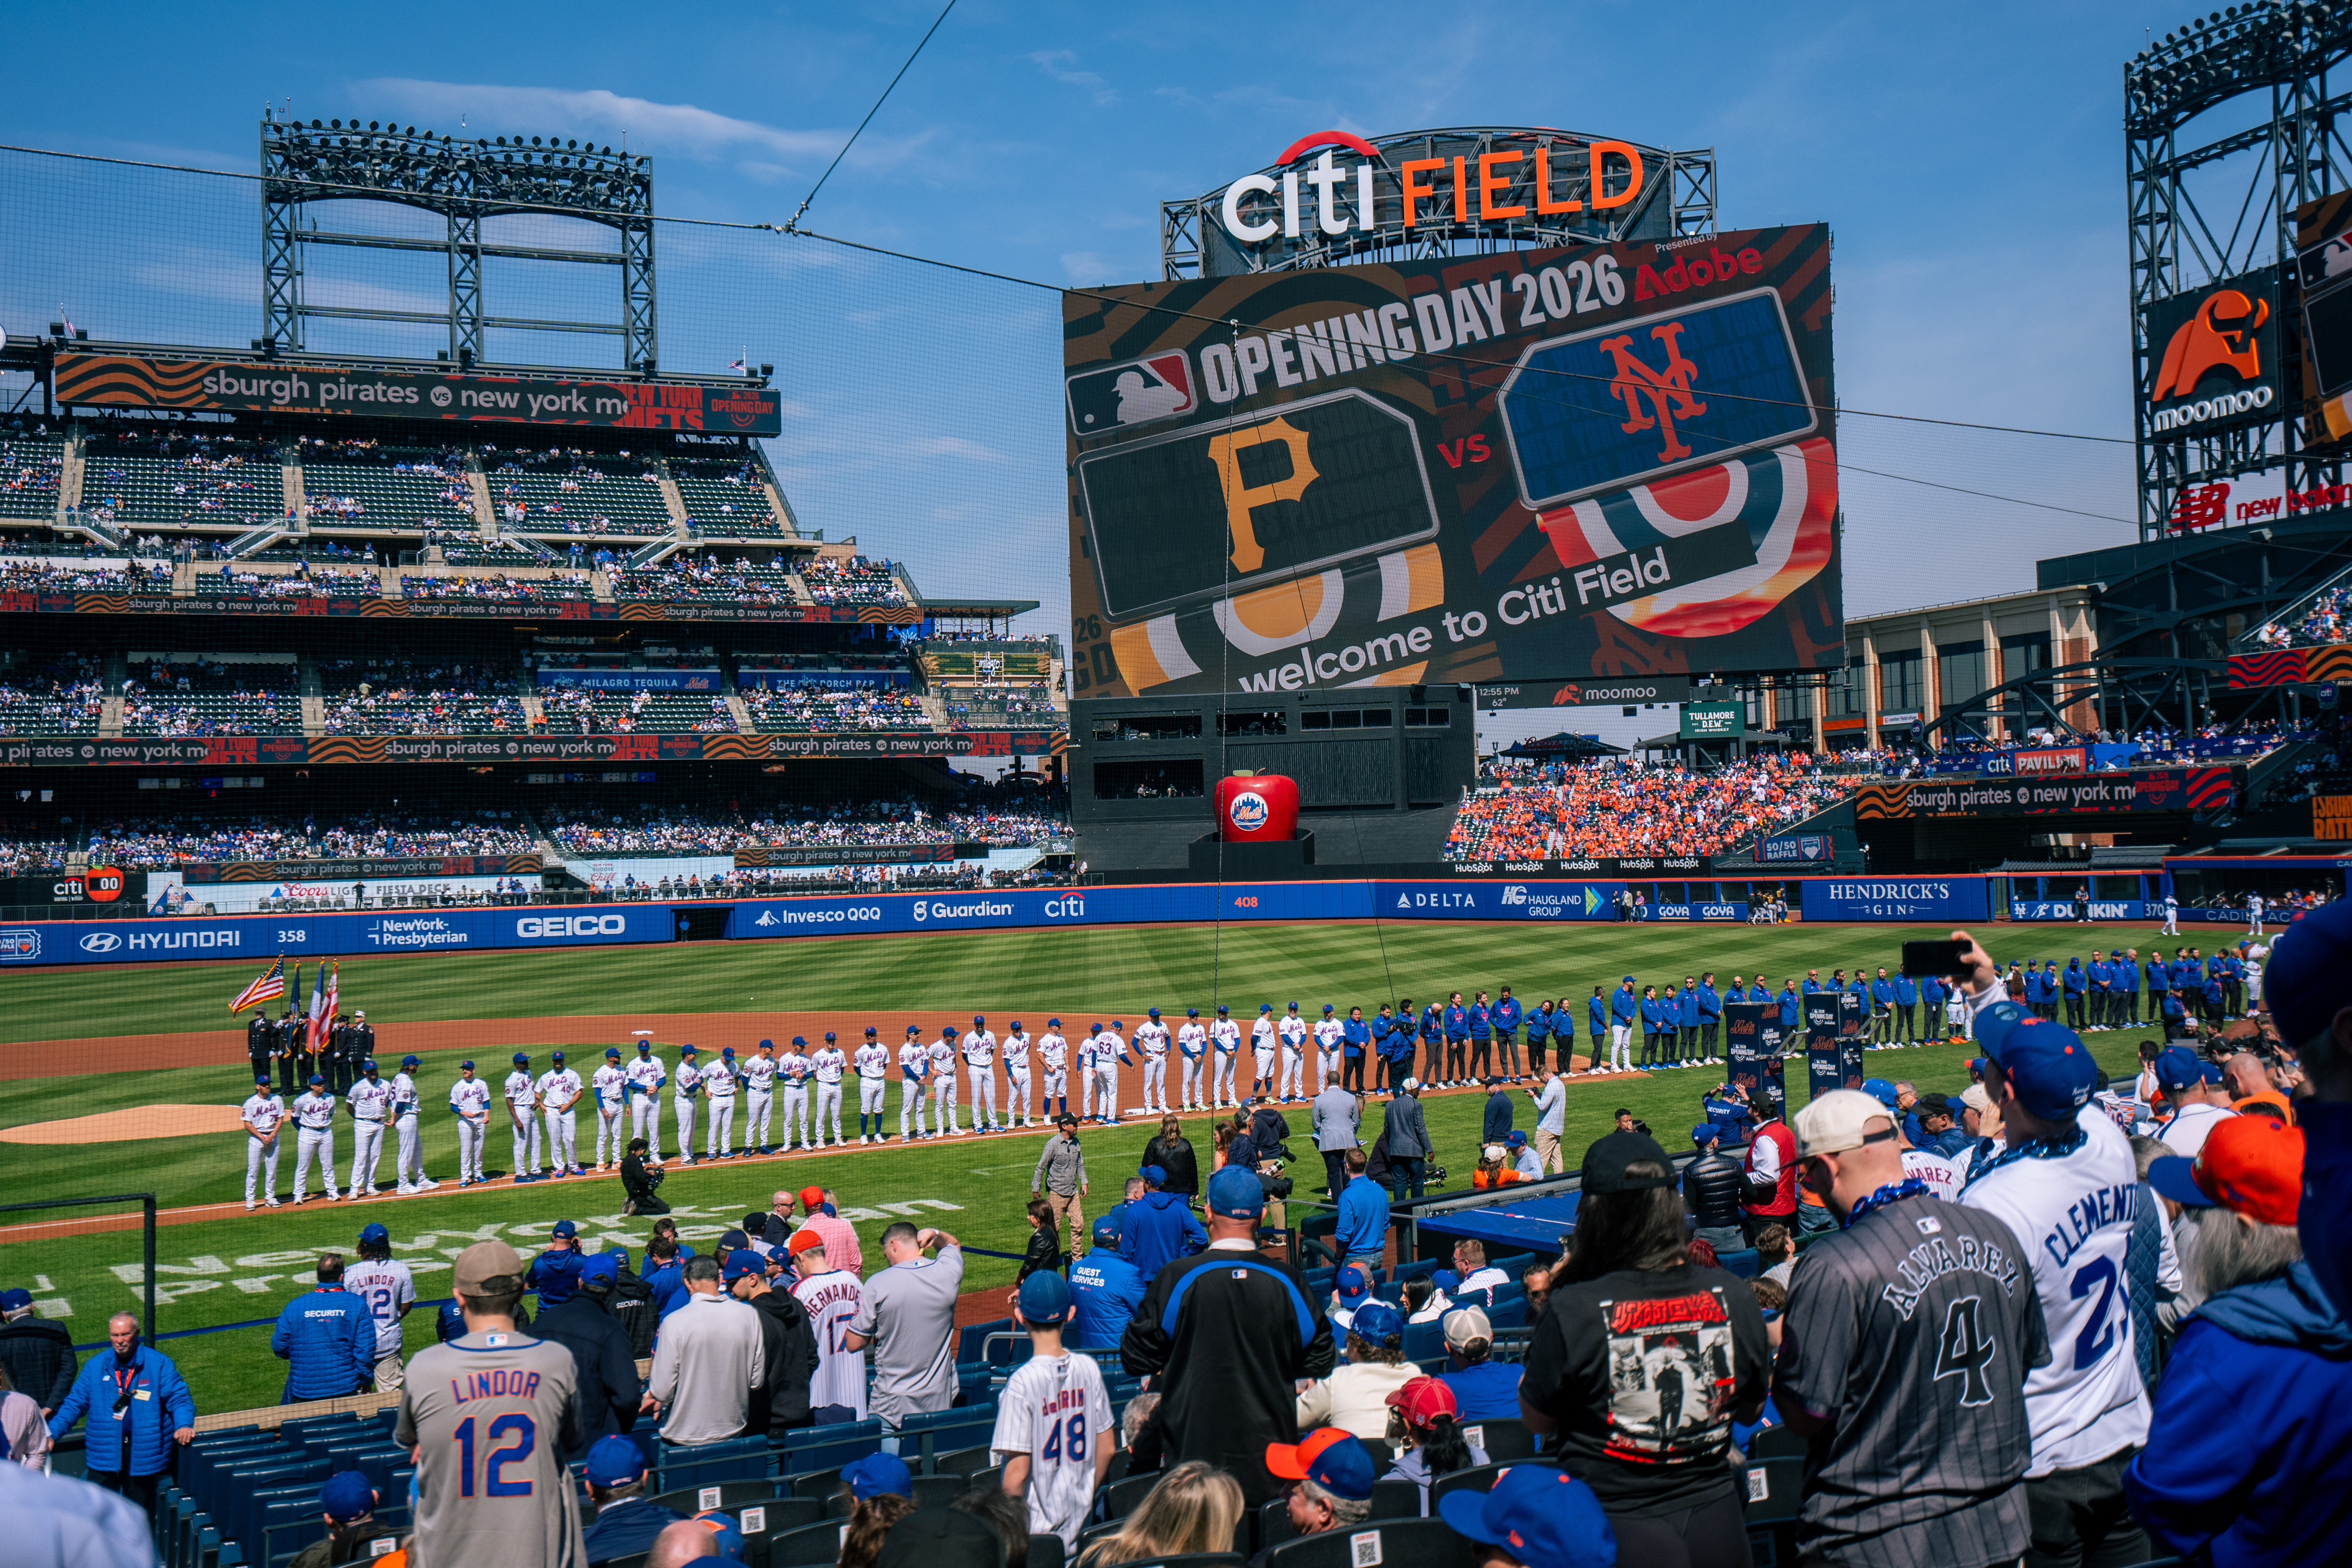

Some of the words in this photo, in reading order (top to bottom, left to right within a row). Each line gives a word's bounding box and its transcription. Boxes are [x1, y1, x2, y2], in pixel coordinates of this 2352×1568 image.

[1221, 148, 1375, 242] citi
[1402, 141, 1643, 227] FIELD
[1654, 235, 1702, 254] Presented
[1200, 300, 1416, 405] OPENING
[1411, 278, 1507, 355] DAY
[1511, 254, 1626, 329] 2026
[1633, 246, 1763, 302] Adobe
[203, 369, 310, 405] sburgh
[319, 377, 419, 407] pirates
[462, 389, 519, 409] new
[527, 389, 589, 417] york
[660, 385, 703, 409] YORK
[743, 391, 760, 400] 2026
[711, 399, 753, 414] OPENING
[754, 402, 774, 414] DAY
[2153, 386, 2273, 432] moomoo
[623, 407, 704, 430] METS
[1436, 433, 1491, 469] vs
[2236, 496, 2283, 521] new
[175, 600, 212, 611] pirates
[255, 600, 280, 613] york
[701, 607, 734, 620] pirates
[770, 607, 791, 619] york
[1238, 626, 1433, 693] welcome
[1442, 610, 1488, 643] to
[1498, 577, 1566, 624] Citi
[1574, 546, 1671, 606] Field
[583, 678, 630, 687] MILAGRO
[634, 678, 678, 687] TEQUILA
[685, 677, 709, 689] Mets
[777, 680, 796, 688] THE
[1479, 687, 1502, 697] 12:55
[1503, 687, 1519, 696] PM
[1586, 686, 1657, 700] moomoo
[1492, 698, 1507, 707] 62°
[1689, 711, 1735, 720] TULLAMORE
[1702, 720, 1723, 728] D.E.W.
[9, 743, 74, 762] pirates
[101, 745, 139, 757] new
[143, 743, 183, 761] york
[385, 740, 441, 758] sburgh
[447, 741, 500, 757] pirates
[523, 743, 556, 753] new
[559, 740, 594, 757] york
[769, 737, 818, 754] sburgh
[823, 738, 871, 754] pirates
[891, 740, 920, 750] new
[923, 737, 954, 753] york
[1987, 756, 2010, 772] citi
[2018, 754, 2080, 772] PAVILIN
[1906, 788, 1956, 814] sburgh
[1960, 783, 2012, 808] pirates
[2033, 785, 2069, 803] new
[2073, 780, 2110, 807] york
[1235, 805, 1262, 821] Mets
[1766, 841, 1797, 852] 50/50
[1767, 850, 1798, 860] RAFFLE
[1455, 862, 1493, 873] HubSpot
[1505, 861, 1544, 872] HubSpot
[1561, 859, 1599, 871] HubSpot
[1620, 858, 1655, 870] HubSpot
[1663, 857, 1699, 868] HubSpot
[54, 880, 82, 895] citi
[100, 878, 118, 890] 00
[288, 882, 329, 897] Coors
[376, 885, 413, 894] FIESTA
[418, 884, 450, 893] DECK
[1045, 895, 1084, 918] citi
[1234, 896, 1258, 908] 408
[1416, 893, 1475, 908] DELTA
[1529, 895, 1581, 905] HAUGLAND
[783, 910, 843, 924] Invesco
[847, 907, 881, 921] QQQ
[931, 901, 1011, 918] Guardian
[1529, 907, 1561, 917] GROUP
[1658, 906, 1689, 917] GOYA
[1702, 905, 1734, 917] GOYA
[1873, 904, 1906, 915] GIN
[2053, 902, 2129, 918] DUKIN'
[2145, 902, 2165, 917] 370
[383, 918, 449, 932] NewYork-
[516, 914, 626, 938] GEICO
[129, 931, 240, 950] HYUNDAI
[277, 929, 306, 943] 358
[383, 930, 467, 947] Presbyterian
[1762, 1003, 1779, 1019] Mets
[1288, 1022, 1302, 1034] Mets
[1321, 1025, 1338, 1035] Mets
[1730, 1019, 1755, 1035] Mets
[973, 1038, 991, 1050] Mets
[1098, 1041, 1112, 1055] 63
[1811, 1036, 1836, 1051] Mets
[821, 1056, 840, 1069] Mets
[864, 1051, 883, 1064] Mets
[637, 1064, 657, 1077] Mets
[547, 1075, 567, 1089] Mets
[560, 1085, 570, 1094] 40
[365, 1087, 385, 1101] Mets
[462, 1086, 482, 1101] Mets
[253, 1102, 276, 1118] Mets
[308, 1104, 329, 1115] Mets
[1706, 1105, 1730, 1115] SECURITY
[1077, 1266, 1101, 1278] GUEST
[1882, 1234, 2020, 1322] ALVAREZ
[356, 1274, 395, 1288] LINDOR
[1071, 1274, 1105, 1288] SERVICES
[304, 1309, 346, 1318] SECURITY
[826, 1312, 855, 1356] 17
[1933, 1295, 1996, 1408] 4
[450, 1369, 542, 1405] LINDOR
[1041, 1411, 1087, 1468] 48
[452, 1412, 537, 1499] 12
